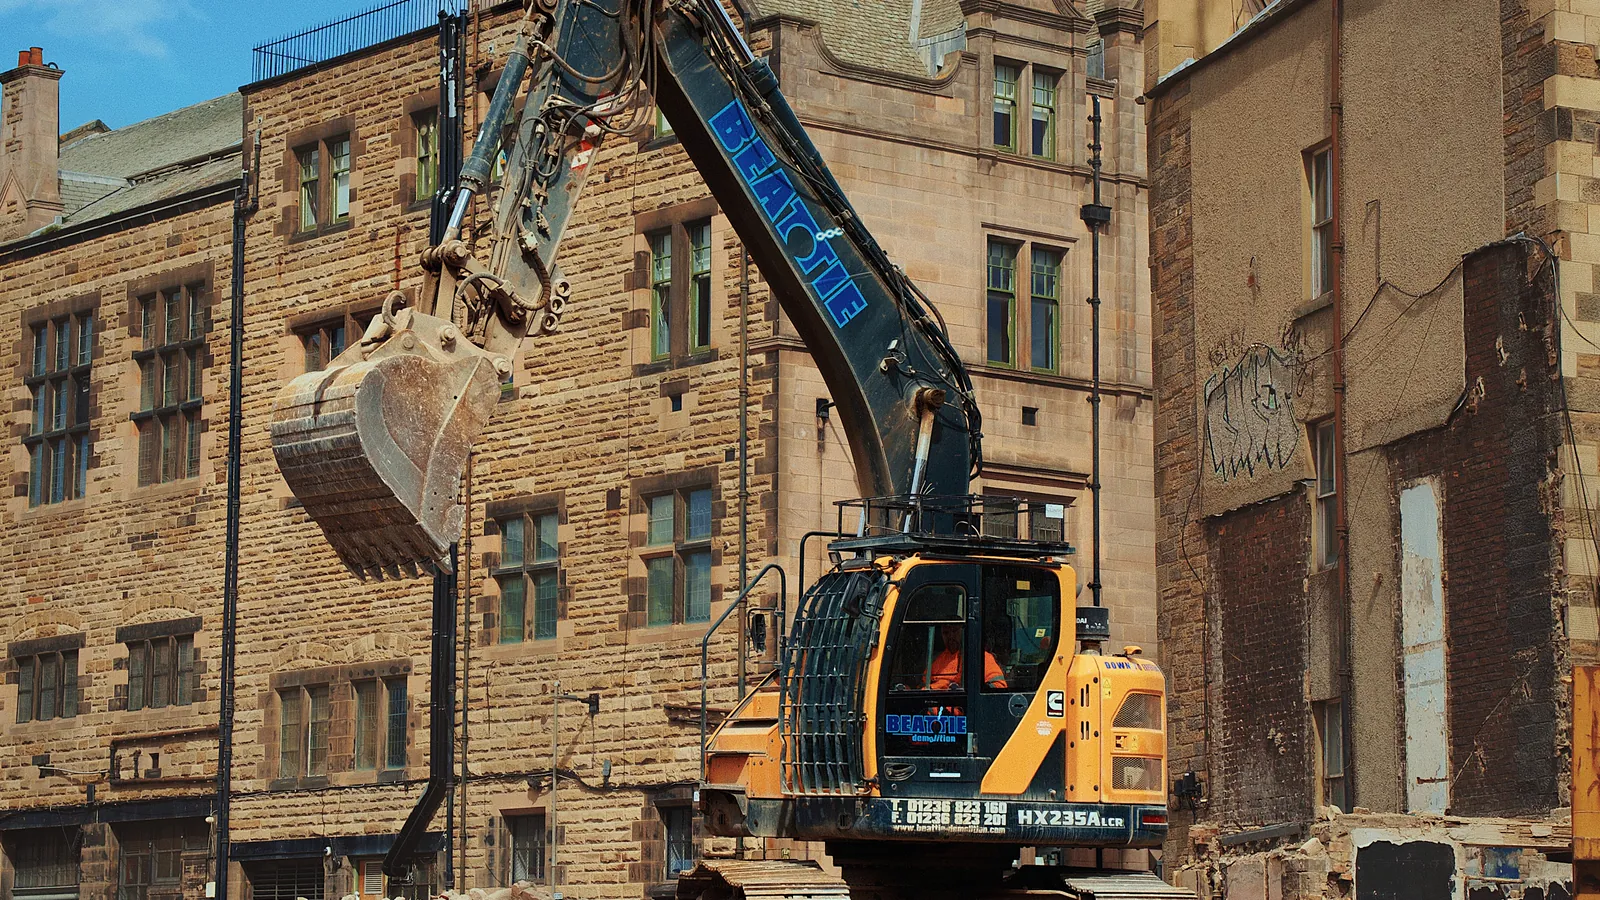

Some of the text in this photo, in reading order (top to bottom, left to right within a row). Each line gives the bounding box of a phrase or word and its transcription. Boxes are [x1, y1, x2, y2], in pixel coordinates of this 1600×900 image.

[708, 98, 868, 328] BEATTIE
[1104, 661, 1131, 669] DOWN
[886, 714, 967, 734] BEATTIE
[912, 734, 956, 743] demolition
[891, 800, 1007, 813] T. 01236 823 160
[891, 812, 1007, 826] F. 01236 823 201
